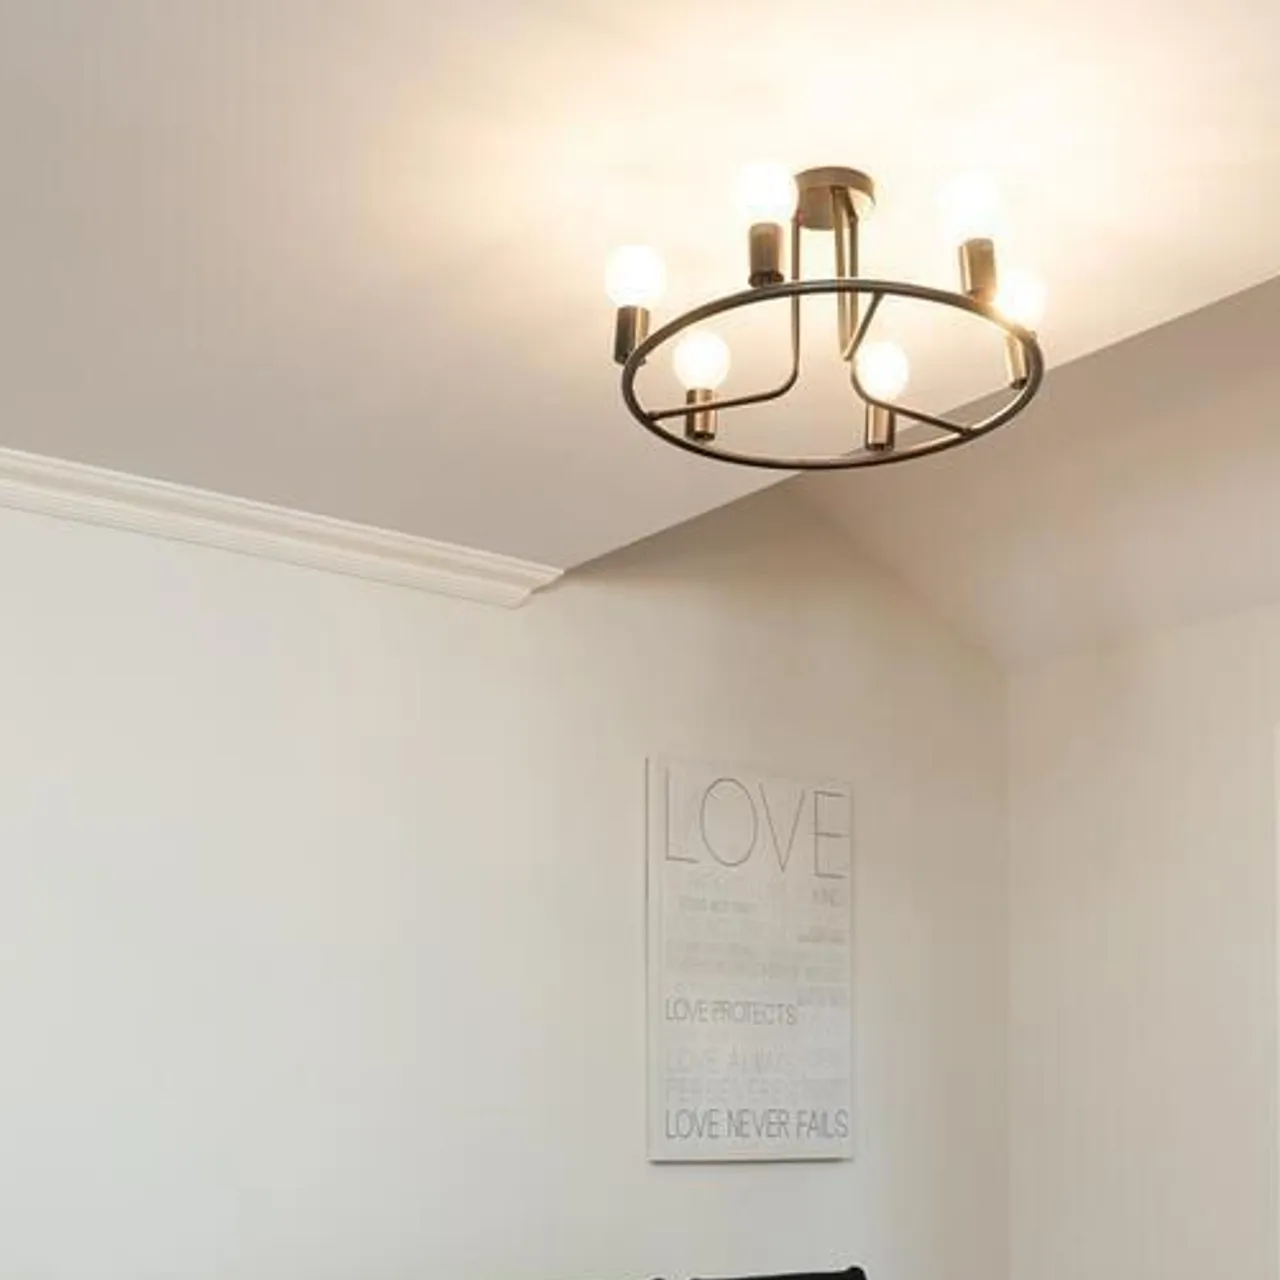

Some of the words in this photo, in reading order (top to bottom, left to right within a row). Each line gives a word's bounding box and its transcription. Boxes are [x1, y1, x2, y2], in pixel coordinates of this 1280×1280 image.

[665, 766, 851, 879] LOVE
[665, 997, 708, 1023] LOVE
[711, 1000, 798, 1026] PROTECTS
[665, 1108, 720, 1140] LOVE
[726, 1107, 791, 1140] NEVER
[795, 1108, 850, 1140] FAILS
